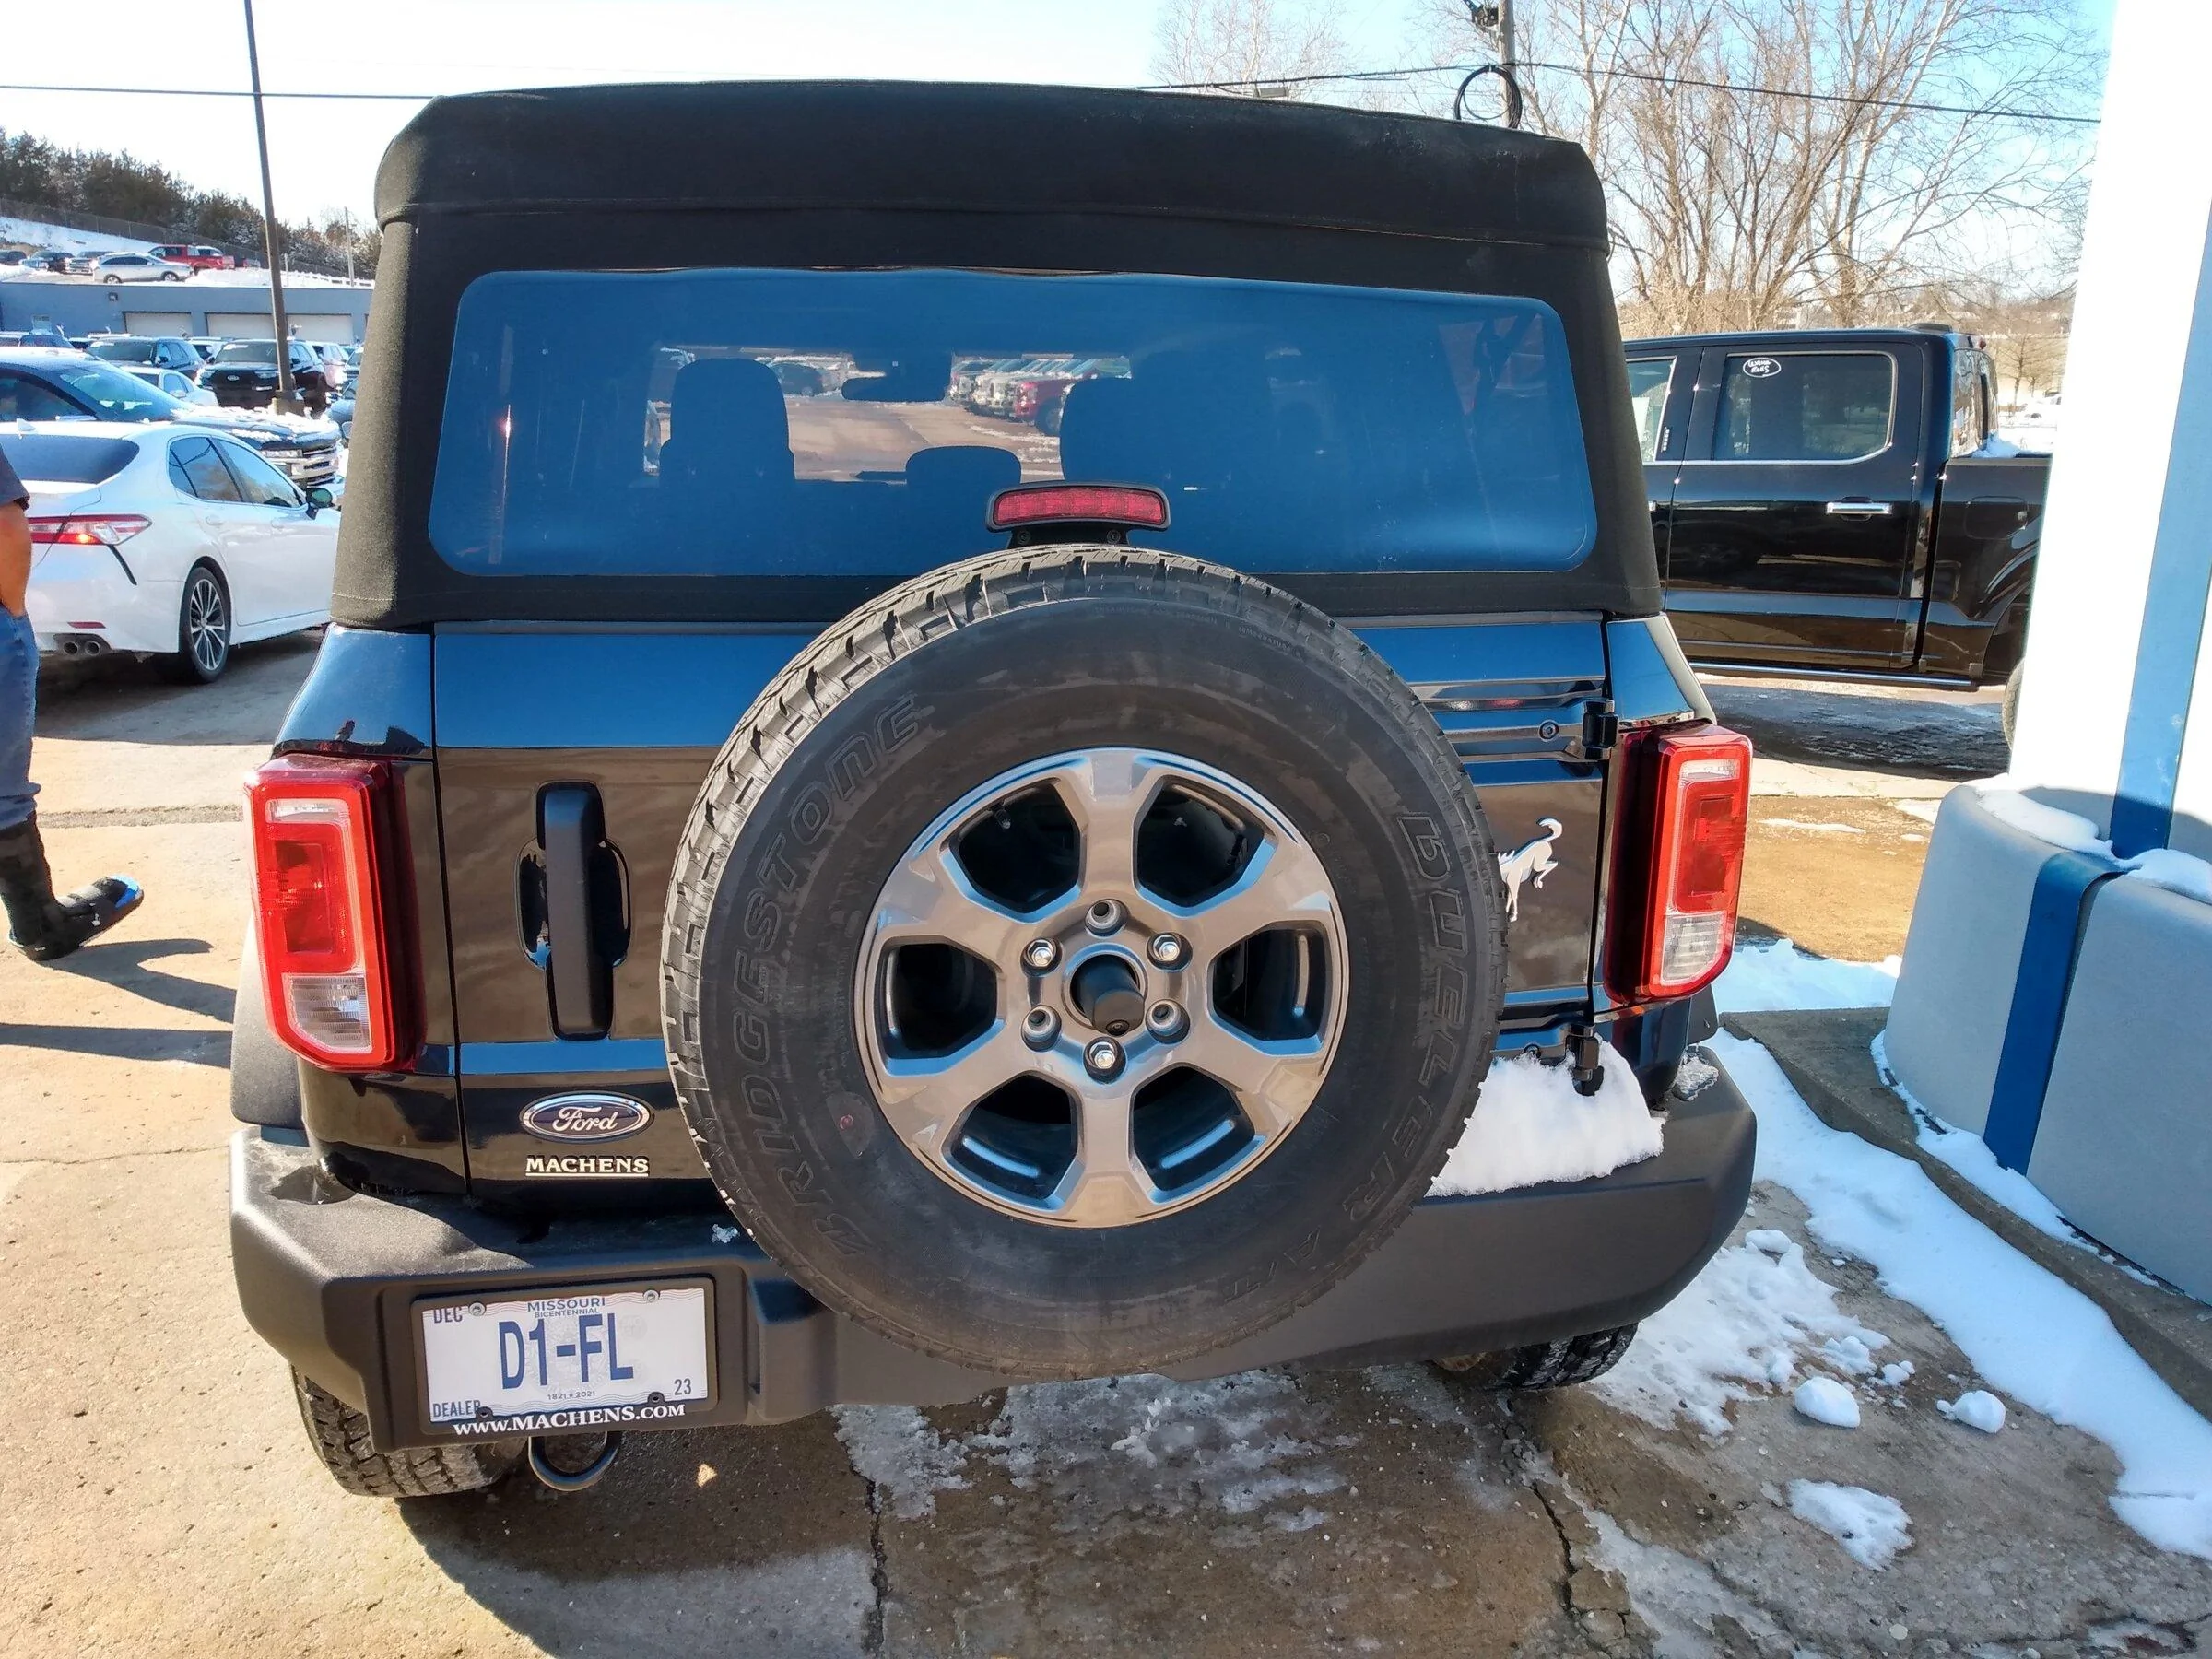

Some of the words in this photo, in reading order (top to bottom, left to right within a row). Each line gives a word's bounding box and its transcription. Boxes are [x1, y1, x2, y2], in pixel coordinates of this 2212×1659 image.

[732, 692, 929, 1258] BRIDGESTONE
[1342, 811, 1470, 1222] DUELER
[553, 1106, 619, 1132] Ford
[525, 1157, 649, 1177] MACHENS
[527, 1296, 606, 1312] MISSOURI
[534, 1307, 600, 1319] BICENTENNIAL
[433, 1306, 463, 1324] DEC
[498, 1312, 634, 1390] D1-FL
[547, 1393, 568, 1401] 1821
[575, 1390, 596, 1398] 2021
[674, 1379, 692, 1396] 23
[432, 1400, 481, 1418] DEALER
[453, 1404, 686, 1436] WWW.MACHENS.COM
